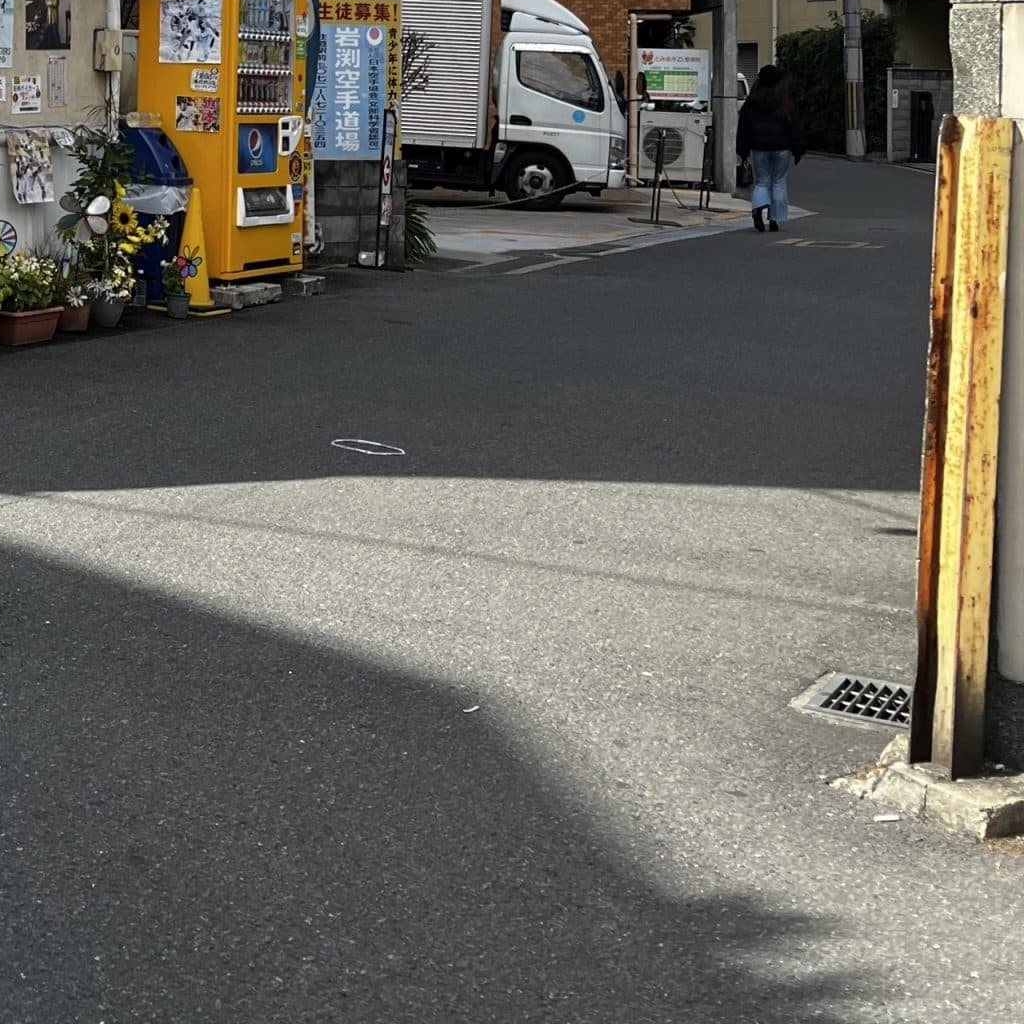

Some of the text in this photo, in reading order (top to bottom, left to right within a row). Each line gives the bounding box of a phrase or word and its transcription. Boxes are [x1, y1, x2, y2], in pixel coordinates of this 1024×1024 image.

[334, 26, 361, 152] 岩渕空手道場
